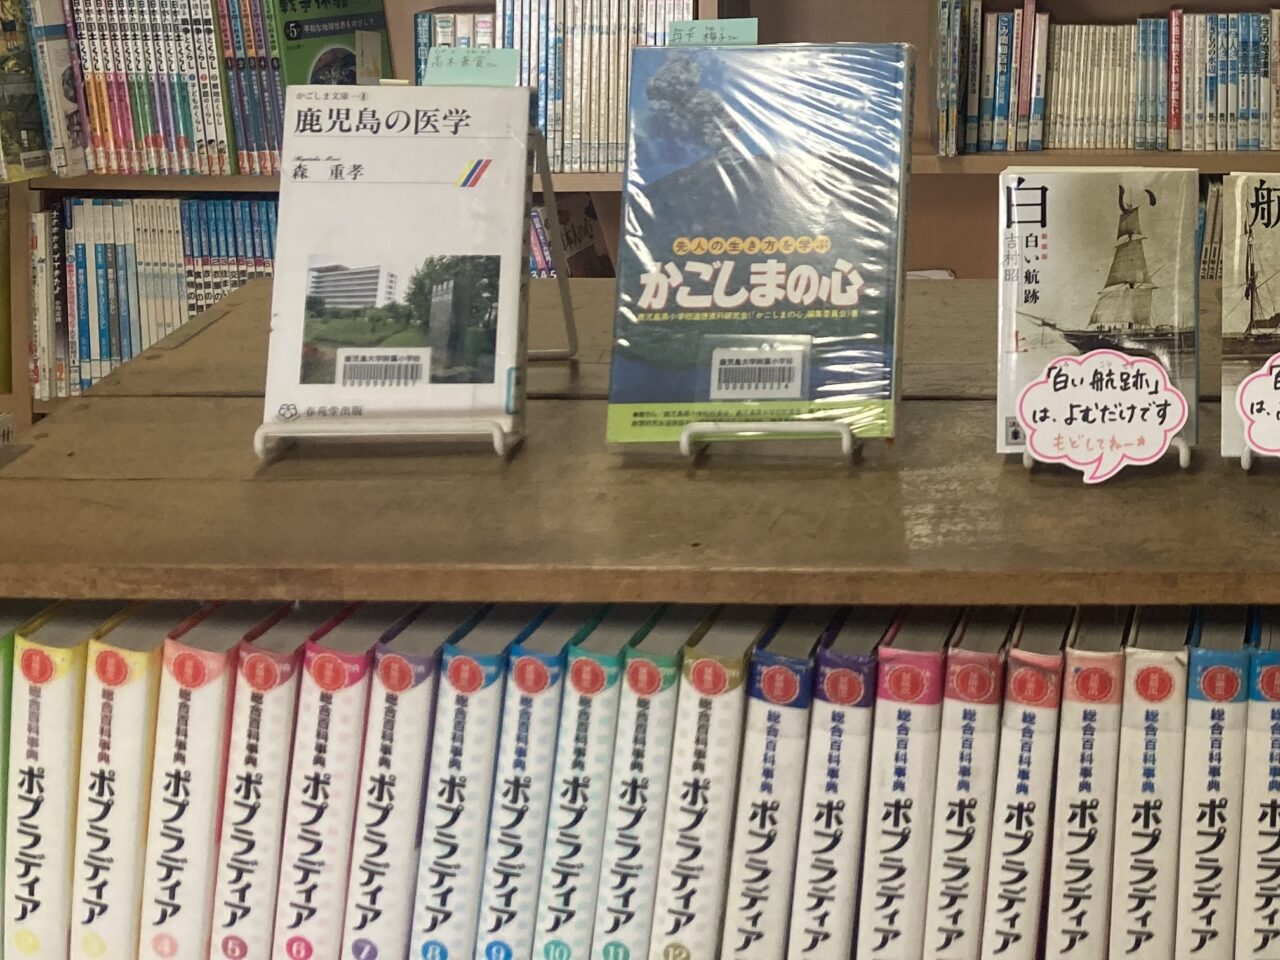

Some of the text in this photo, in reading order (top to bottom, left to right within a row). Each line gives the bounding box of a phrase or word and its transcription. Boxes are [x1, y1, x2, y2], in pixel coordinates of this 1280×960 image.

[289, 23, 297, 37] 5
[292, 164, 364, 180] 森 重孝
[294, 108, 472, 135] 鹿児島の医学
[672, 237, 832, 256] 先人の生き方を学ぶ
[1003, 233, 1020, 283] 吉村昭
[1006, 176, 1157, 229] 白 い
[1024, 233, 1040, 304] 白い航跡
[637, 258, 864, 310] かごしまの心
[1006, 330, 1028, 353] 上
[1032, 400, 1171, 425] は、よむだけです
[15, 766, 44, 921] ポプラディア
[153, 769, 190, 925] ポプラディア
[287, 771, 330, 928] ポプラディア
[423, 775, 467, 932] ポプラディア
[545, 776, 590, 932] ポプラディア
[666, 777, 710, 935] ポプラディア
[735, 801, 780, 951] ポプラディア
[802, 799, 845, 952] ポプラディア
[873, 798, 912, 951] ポプラディア
[937, 798, 977, 951] ポプラディア
[994, 802, 1036, 954] ポプラディア
[1060, 798, 1099, 953] ポプラディア
[1126, 798, 1163, 953] ポプラディア
[1190, 798, 1228, 952] ポプラディア
